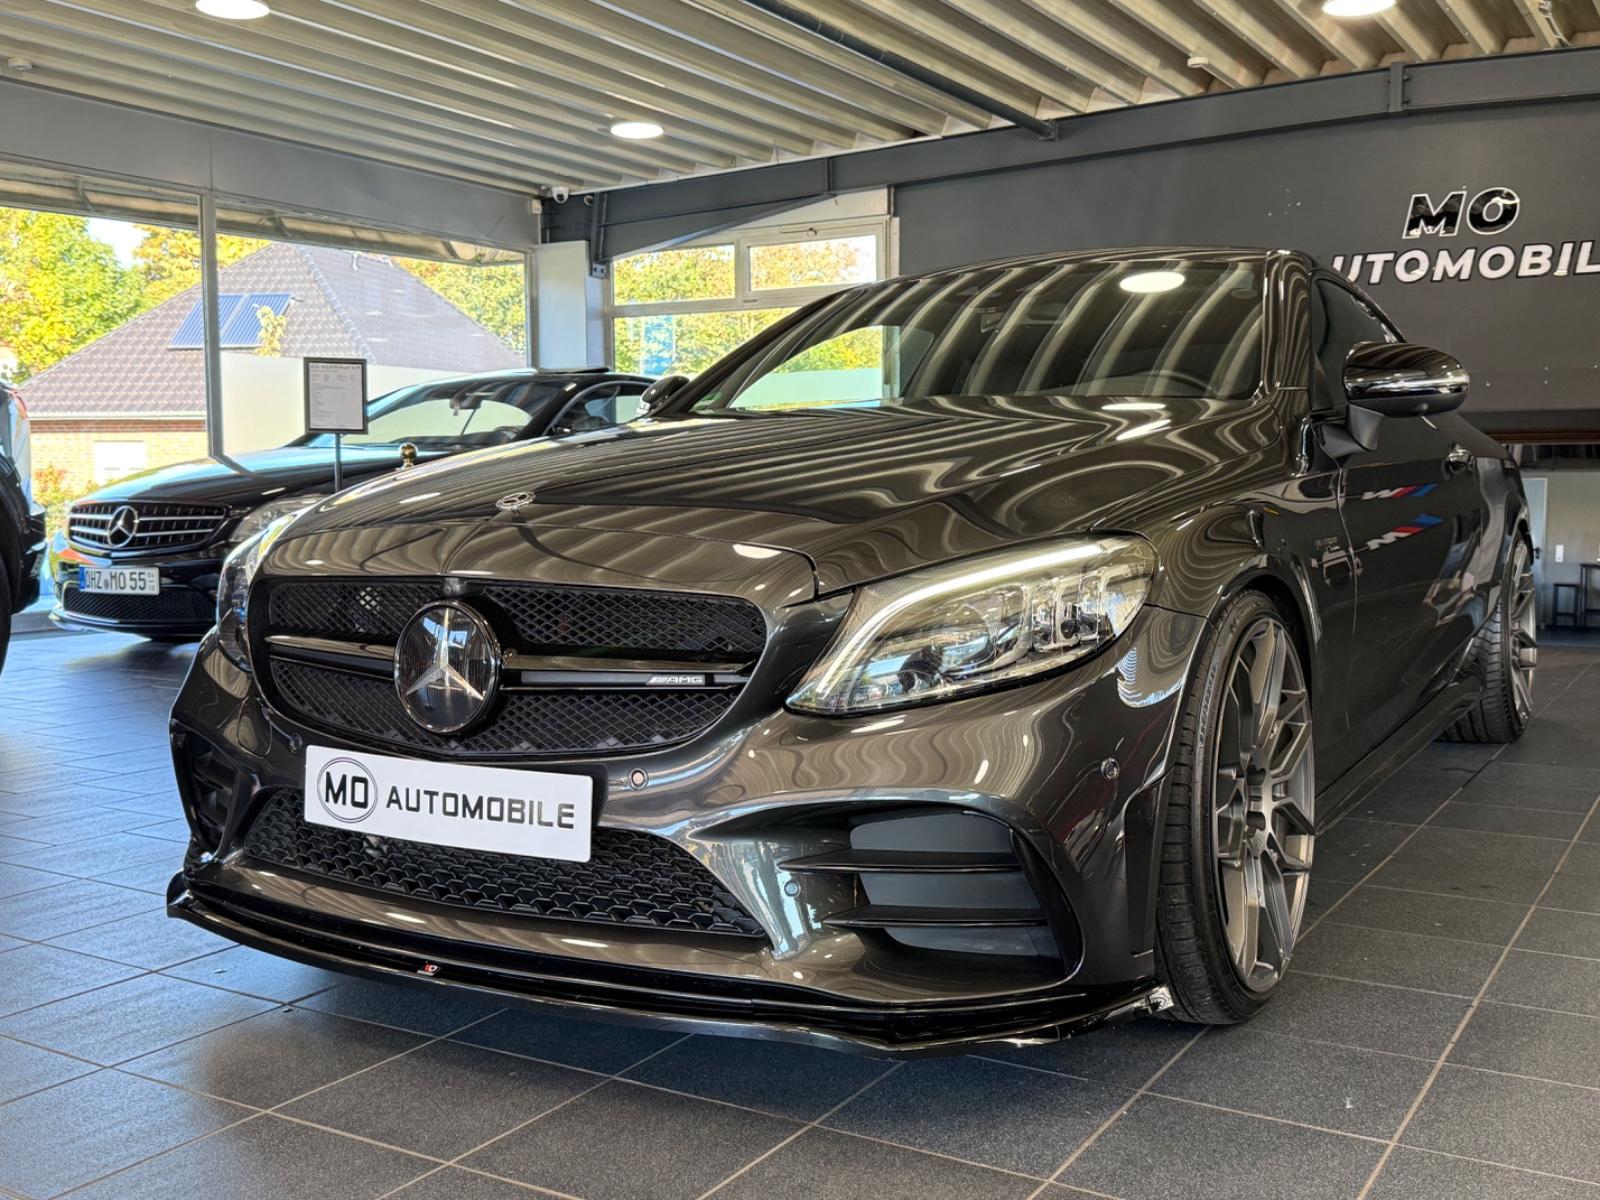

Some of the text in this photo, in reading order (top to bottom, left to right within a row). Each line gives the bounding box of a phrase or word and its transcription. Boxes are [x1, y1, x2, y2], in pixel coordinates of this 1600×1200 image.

[1401, 186, 1521, 240] MO
[129, 571, 147, 591] 55
[325, 771, 576, 830] MO AUTOMOBILE
